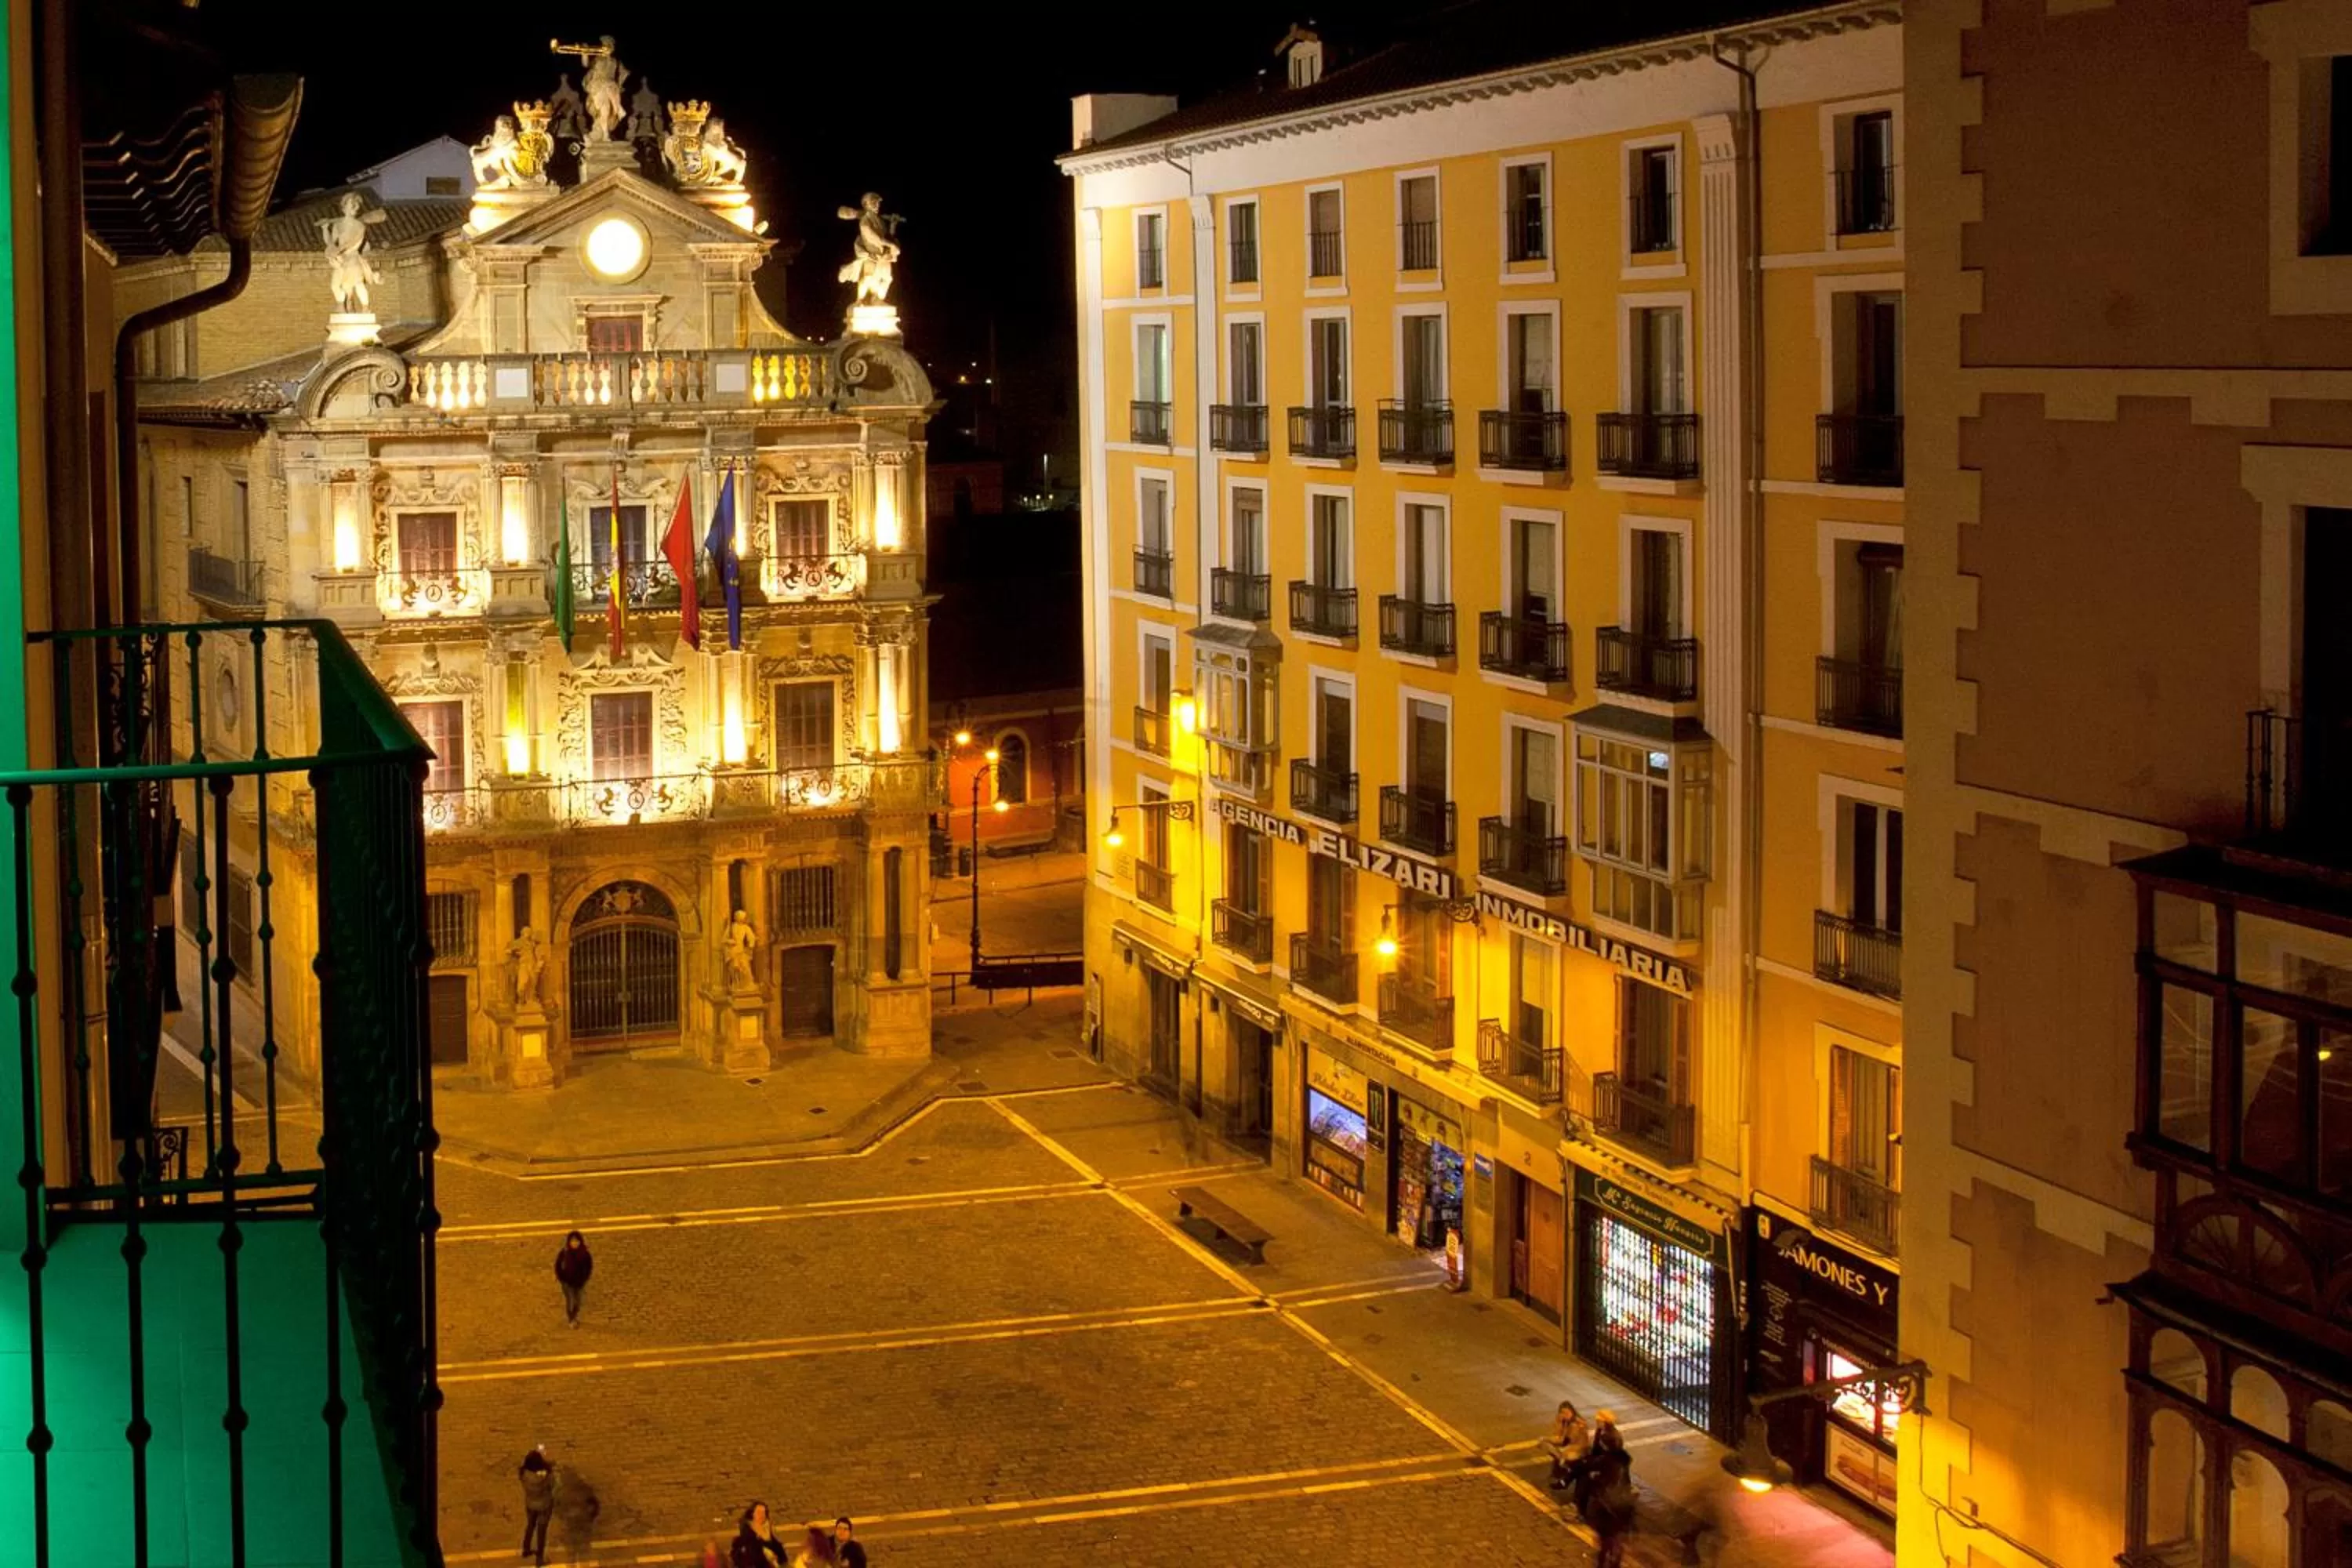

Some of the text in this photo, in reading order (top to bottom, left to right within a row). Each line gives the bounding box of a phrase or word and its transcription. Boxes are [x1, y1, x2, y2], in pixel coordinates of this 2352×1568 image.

[1210, 800, 1687, 992] AGENCIA ELIZARI INMOBILIARIA
[1873, 1282, 1889, 1305] Y
